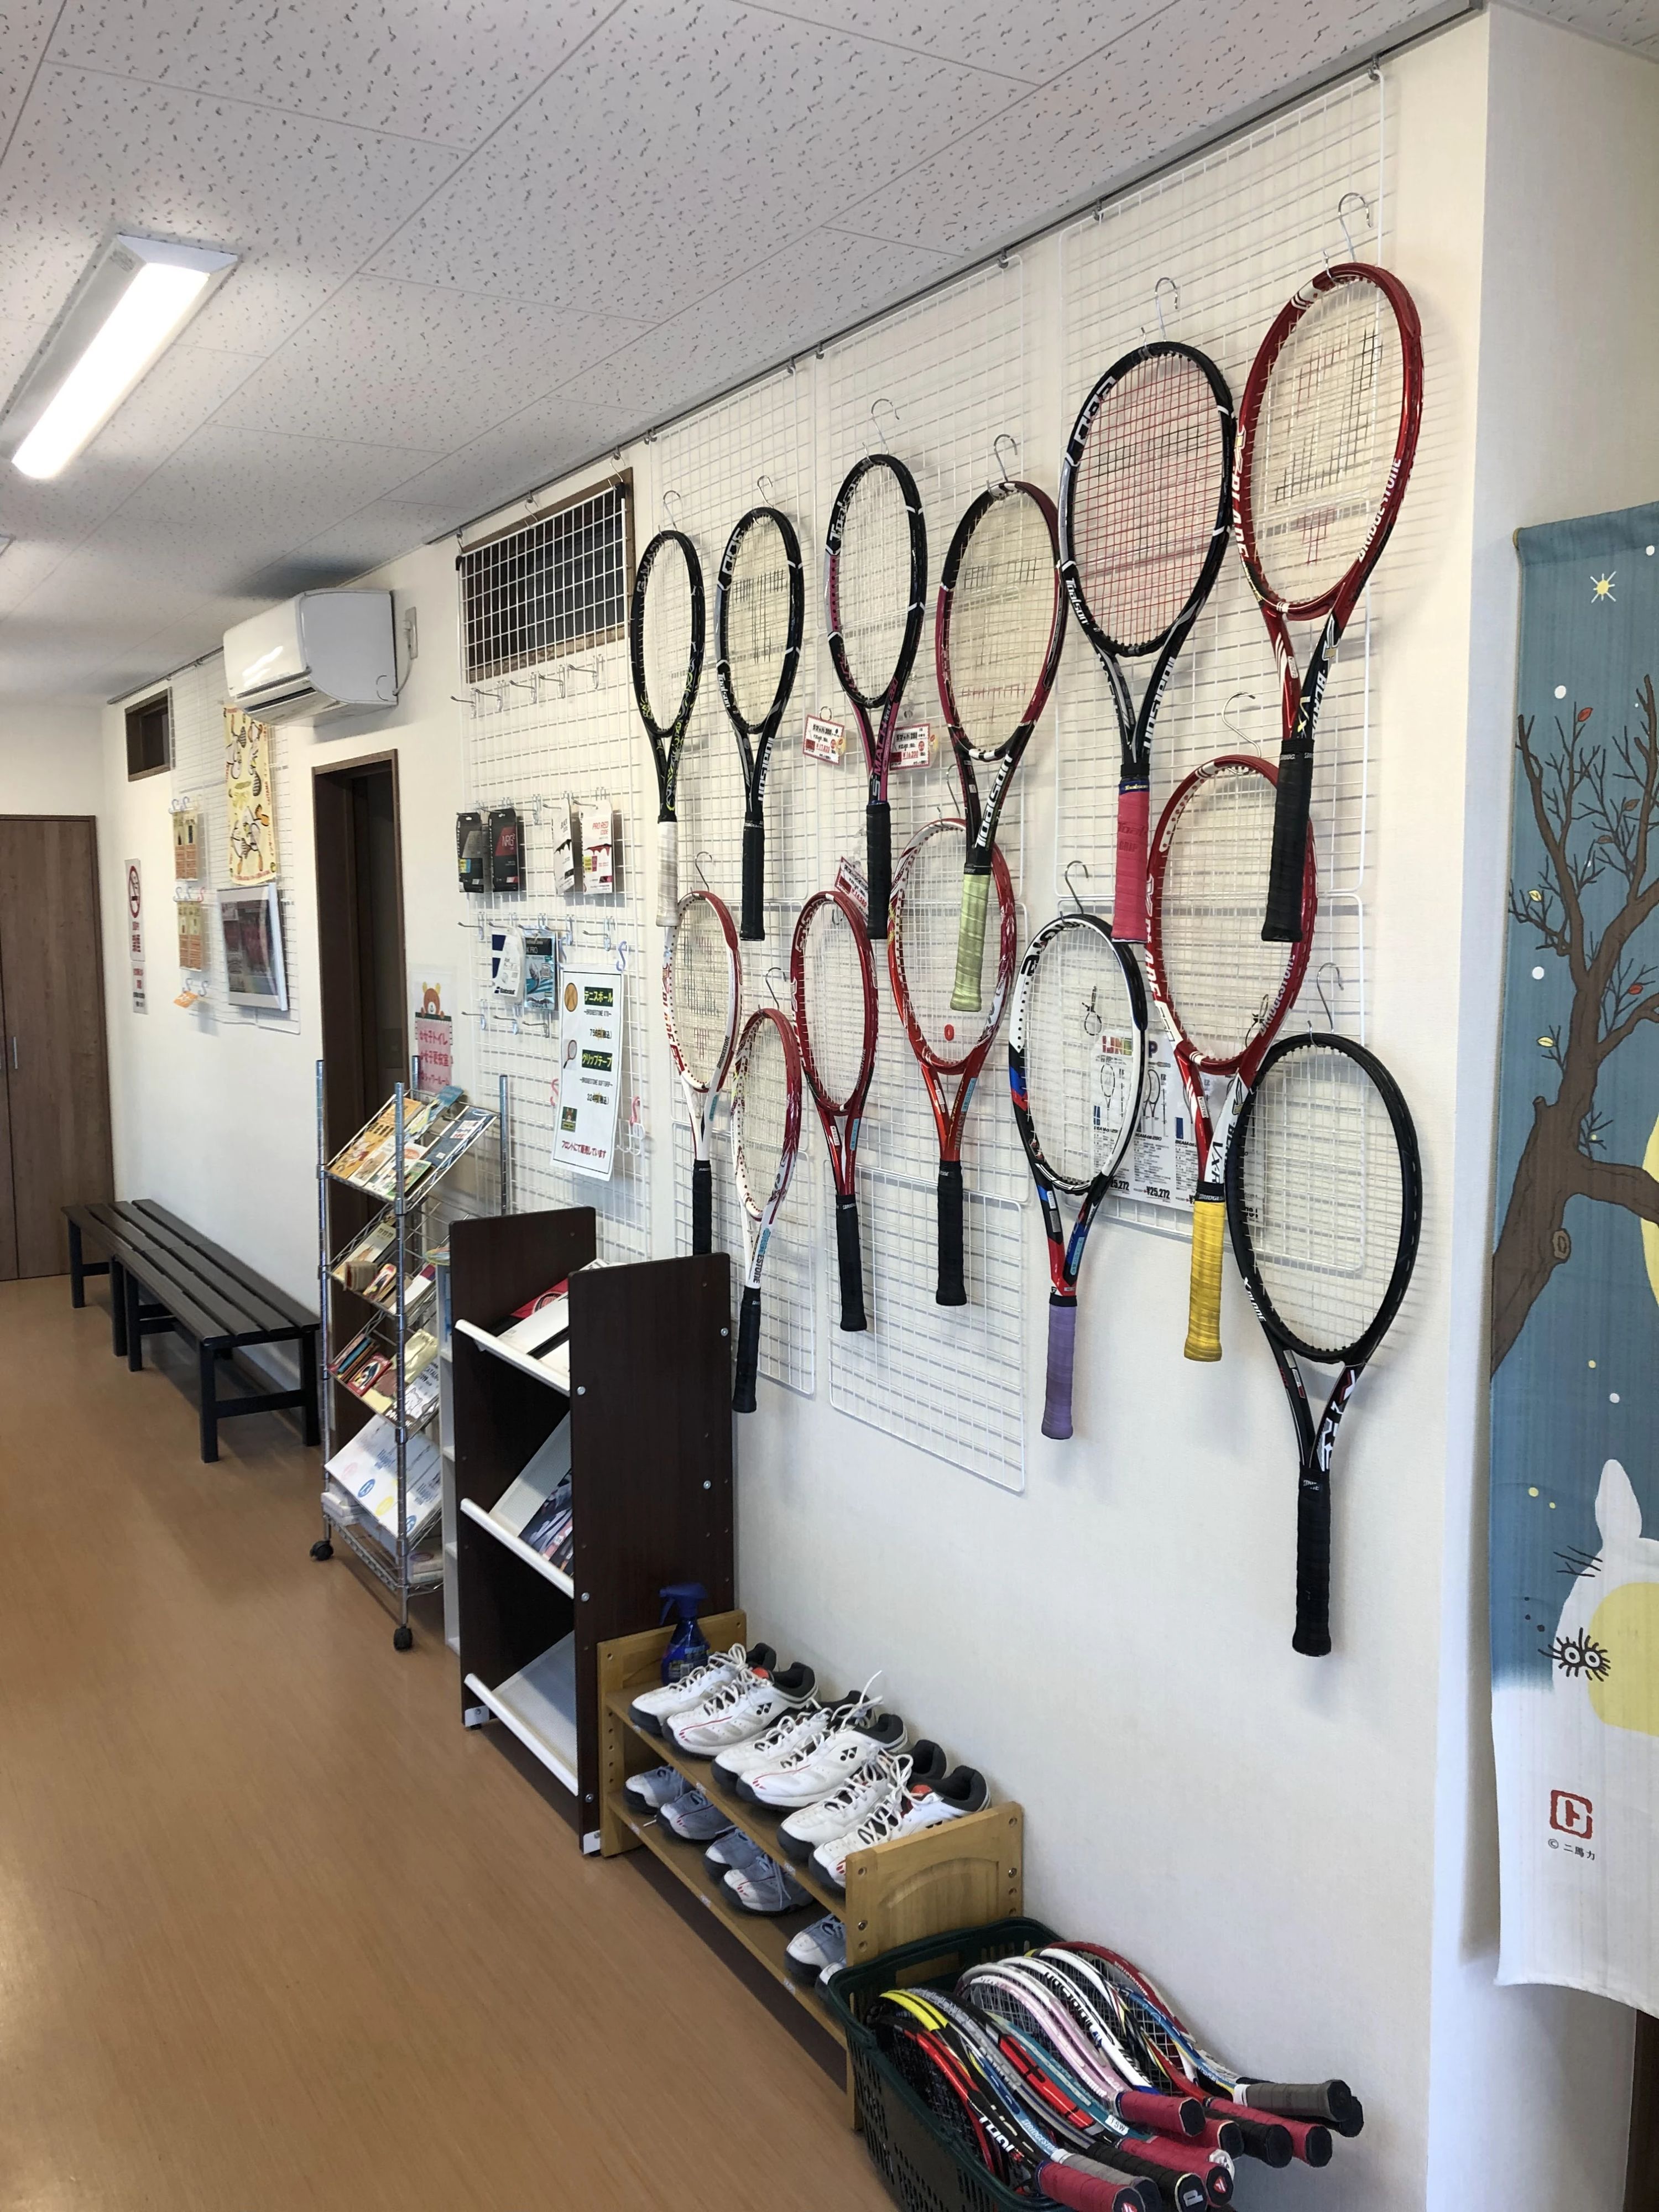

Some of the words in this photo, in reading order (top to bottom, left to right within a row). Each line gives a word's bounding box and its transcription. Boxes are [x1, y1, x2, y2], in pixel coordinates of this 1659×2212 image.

[1065, 578, 1089, 625] Toalson
[975, 754, 1014, 848] Toalson
[584, 990, 613, 1003] テニスボール
[1259, 955, 1296, 1037] BRIDGESTONE
[582, 1053, 612, 1067] グリップテープ
[717, 1034, 731, 1070] BRIDGESTONE
[1146, 1186, 1170, 1200] ¥25,272
